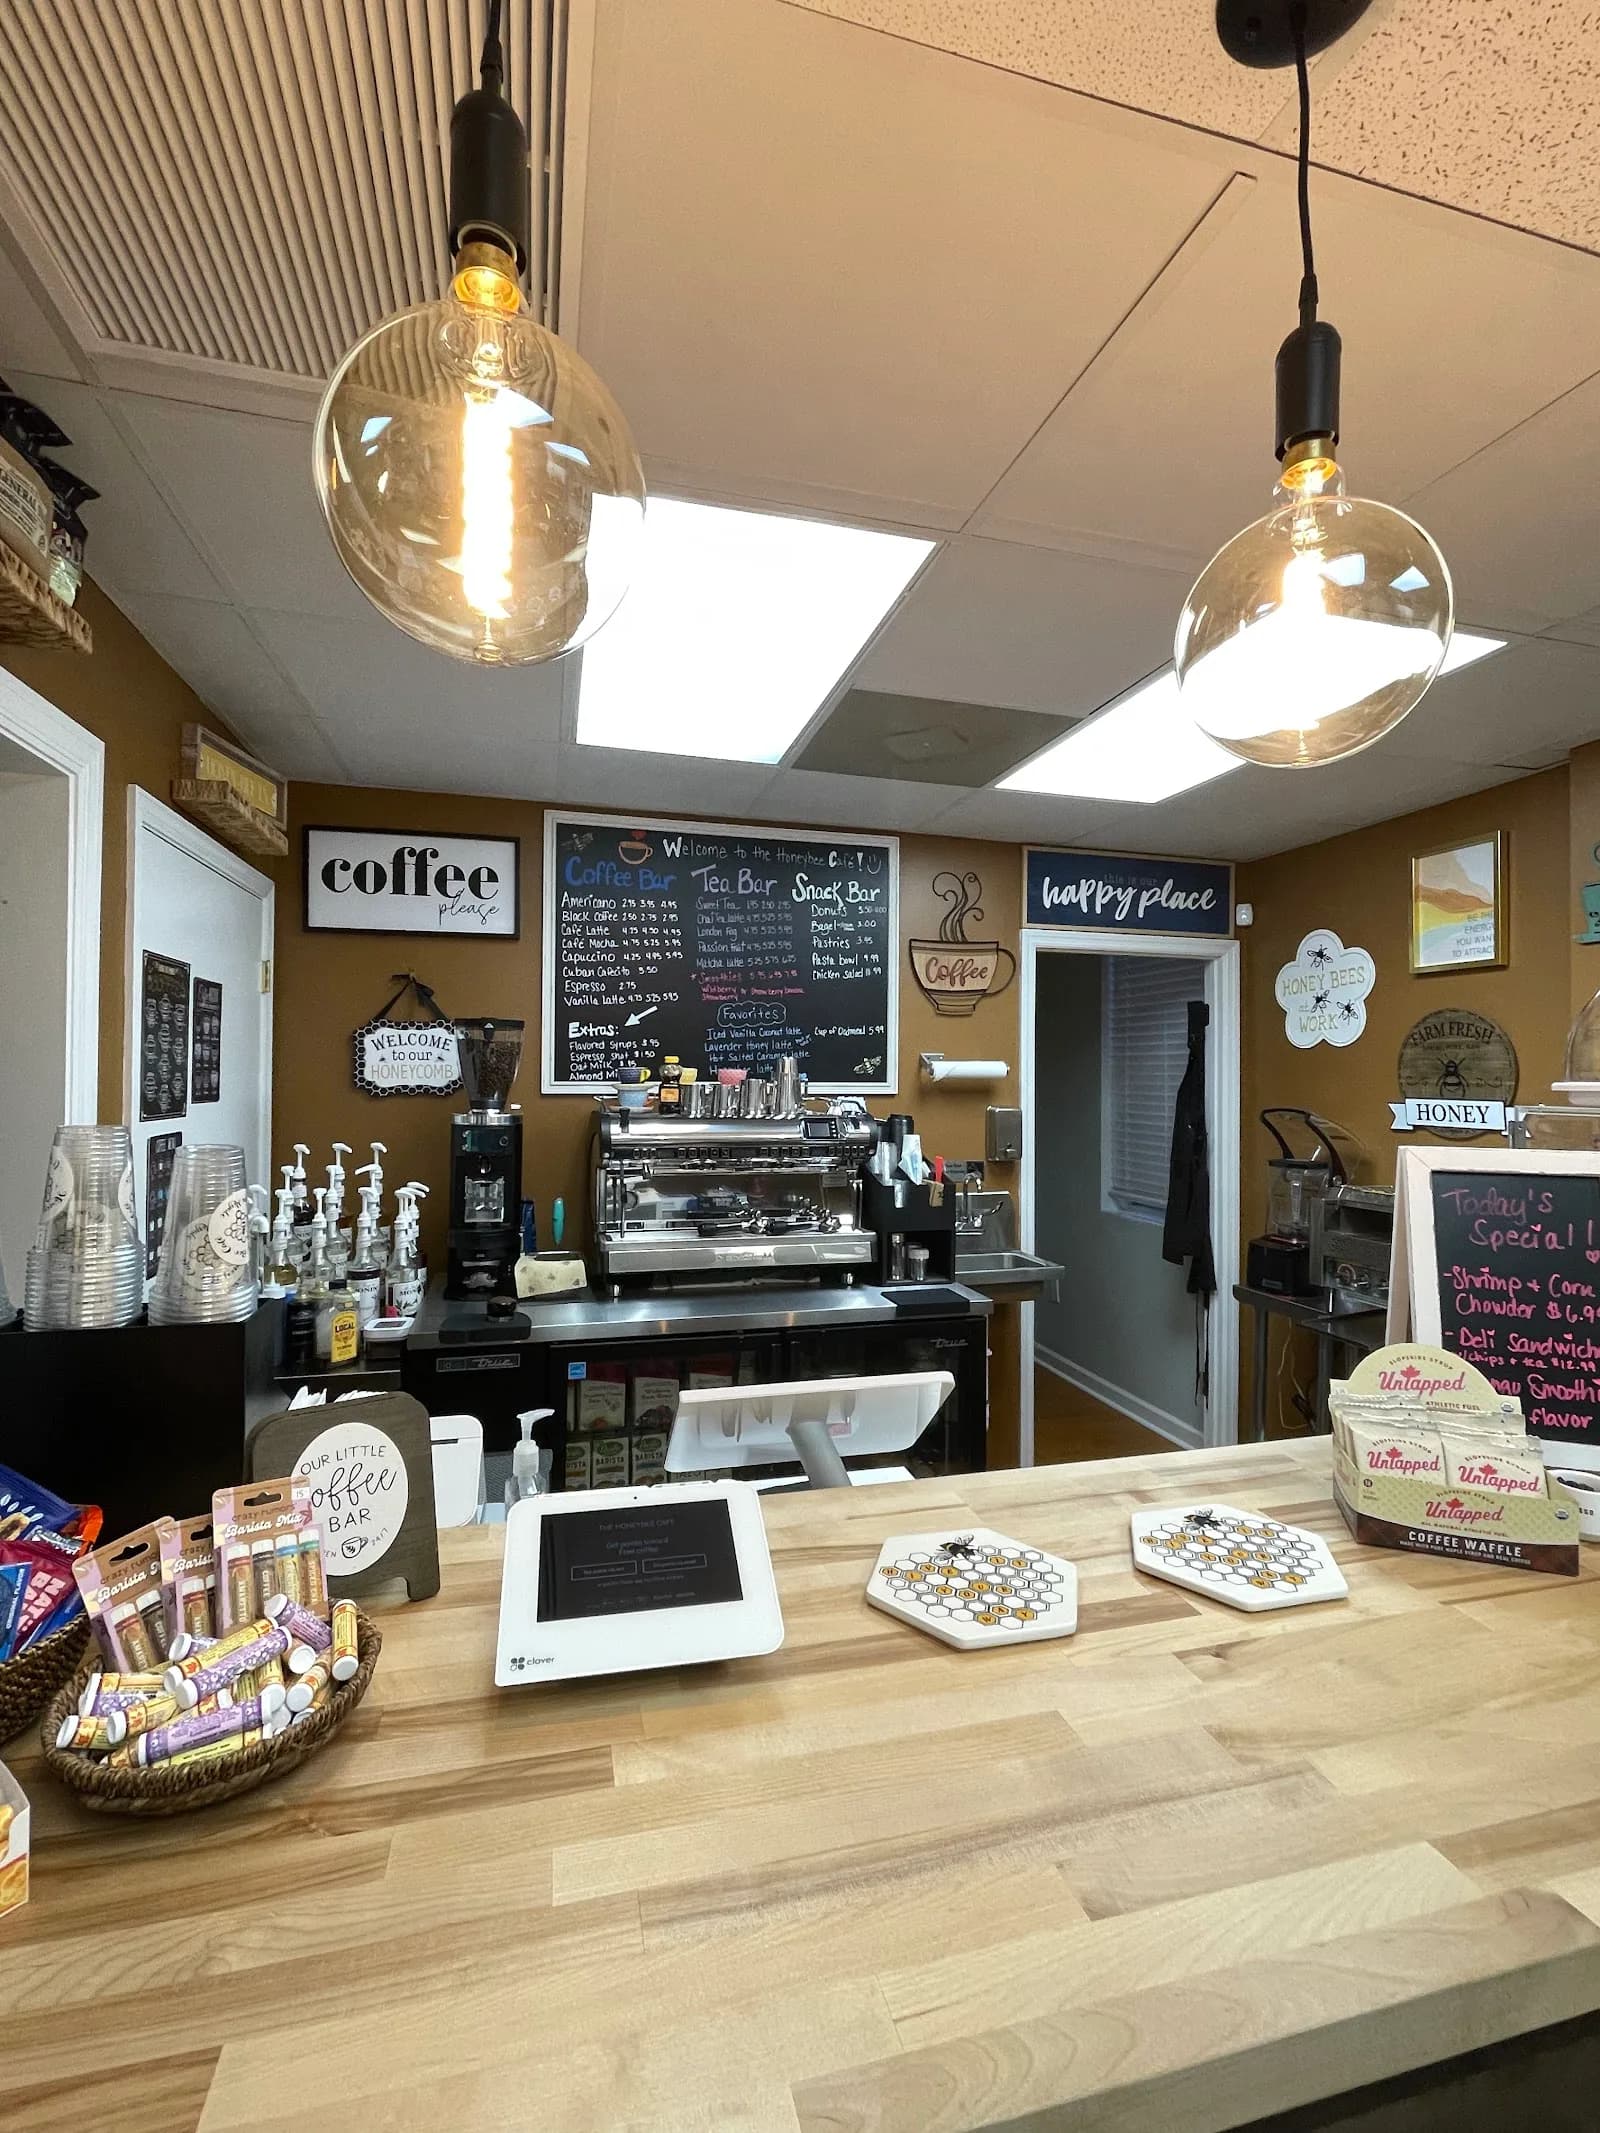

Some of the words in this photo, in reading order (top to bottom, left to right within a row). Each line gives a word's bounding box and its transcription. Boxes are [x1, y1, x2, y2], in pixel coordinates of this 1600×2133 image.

[662, 836, 728, 859] Welcome
[734, 844, 747, 858] to
[752, 845, 772, 861] the
[321, 846, 499, 900] coffee
[565, 855, 633, 887] Coffee
[639, 868, 678, 891] Bar
[690, 863, 737, 895] Tea
[738, 867, 778, 895] Bar
[791, 873, 845, 907] Snack
[846, 881, 881, 903] Bar
[1041, 876, 1138, 922] happy
[1137, 878, 1217, 919] place
[438, 888, 500, 926] please
[561, 891, 616, 909] Americano
[811, 904, 847, 917] Donuts
[561, 923, 583, 937] Café
[586, 924, 610, 936] Latte
[1464, 921, 1494, 934] ENERG
[561, 938, 585, 950] Café
[589, 939, 619, 949] Mocha
[813, 936, 850, 950] Pastries
[1456, 937, 1472, 947] YOU
[1474, 935, 1492, 944] WAN
[562, 950, 616, 965] Capuccino
[812, 952, 835, 966] Pasta
[839, 953, 858, 966] bowl
[1464, 945, 1492, 956] ATTRAC
[562, 966, 595, 978] Cuban
[925, 956, 988, 987] Coffee
[565, 980, 606, 994] Espresso
[1282, 973, 1328, 997] HONEY
[1332, 966, 1366, 989] BEES
[563, 995, 599, 1007] Vanilla
[723, 1006, 780, 1021] Favorites
[568, 1021, 619, 1039] Extras:
[1299, 1013, 1339, 1033] WORK
[370, 1033, 453, 1052] WELCOME
[705, 1028, 726, 1041] Iced
[729, 1028, 756, 1039] Vanilla
[1410, 1022, 1446, 1046] FARM
[1448, 1021, 1494, 1045] FRESH
[392, 1048, 406, 1061] to
[408, 1050, 433, 1061] our
[569, 1040, 605, 1051] Flavored
[704, 1041, 742, 1052] Lavender
[746, 1040, 769, 1053] Honey
[570, 1051, 605, 1062] Espresso
[709, 1052, 724, 1063] Hot
[728, 1050, 754, 1061] Salted
[371, 1063, 454, 1080] HONEYCOMB
[570, 1062, 588, 1072] Oat
[569, 1072, 604, 1081] Almond
[1416, 1103, 1490, 1124] HONEY
[1441, 1187, 1554, 1225] Today's
[1549, 1273, 1596, 1298] Corn
[1456, 1292, 1537, 1320] Chowder
[334, 1322, 355, 1333] LOCAL
[1460, 1327, 1496, 1350] Deli
[1522, 1356, 1548, 1368] tea
[1378, 1366, 1466, 1396] Untapped
[1426, 1401, 1460, 1409] ATHLETIC
[1462, 1403, 1481, 1411] FUEL
[1529, 1408, 1594, 1430] flavor
[301, 1454, 332, 1476] OUR
[336, 1445, 388, 1462] LITTLE
[595, 1456, 625, 1466] BARISTA
[635, 1452, 664, 1461] BARISTA
[1367, 1447, 1441, 1475] Untapped
[1458, 1465, 1540, 1493] Untapped
[1425, 1498, 1505, 1524] Untapped
[225, 1515, 272, 1539] Barista
[329, 1508, 372, 1533] BAR
[1408, 1530, 1459, 1548] COFFEE
[1464, 1538, 1522, 1558] WAFFLE
[13, 1568, 25, 1595] FLAVOR
[101, 1567, 129, 1586] crazy
[98, 1569, 147, 1603] Barista
[526, 1655, 555, 1667] clover
